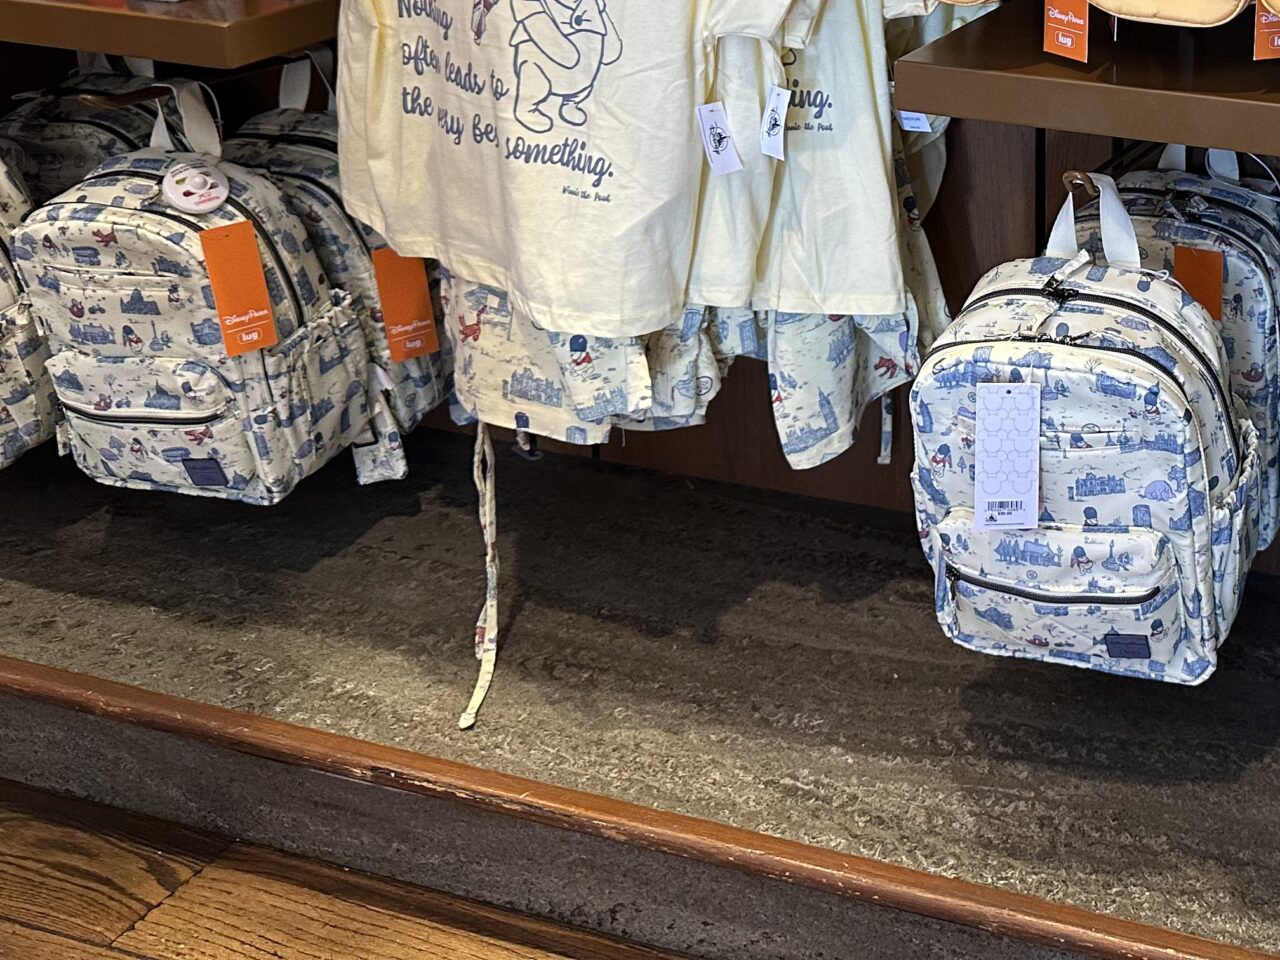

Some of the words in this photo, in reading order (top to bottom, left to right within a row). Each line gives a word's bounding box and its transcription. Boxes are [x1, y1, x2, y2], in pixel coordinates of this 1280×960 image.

[1058, 31, 1072, 48] lug
[445, 51, 485, 96] leads
[490, 69, 510, 101] to
[402, 85, 434, 117] the
[505, 136, 614, 188] something.
[242, 332, 258, 341] lug
